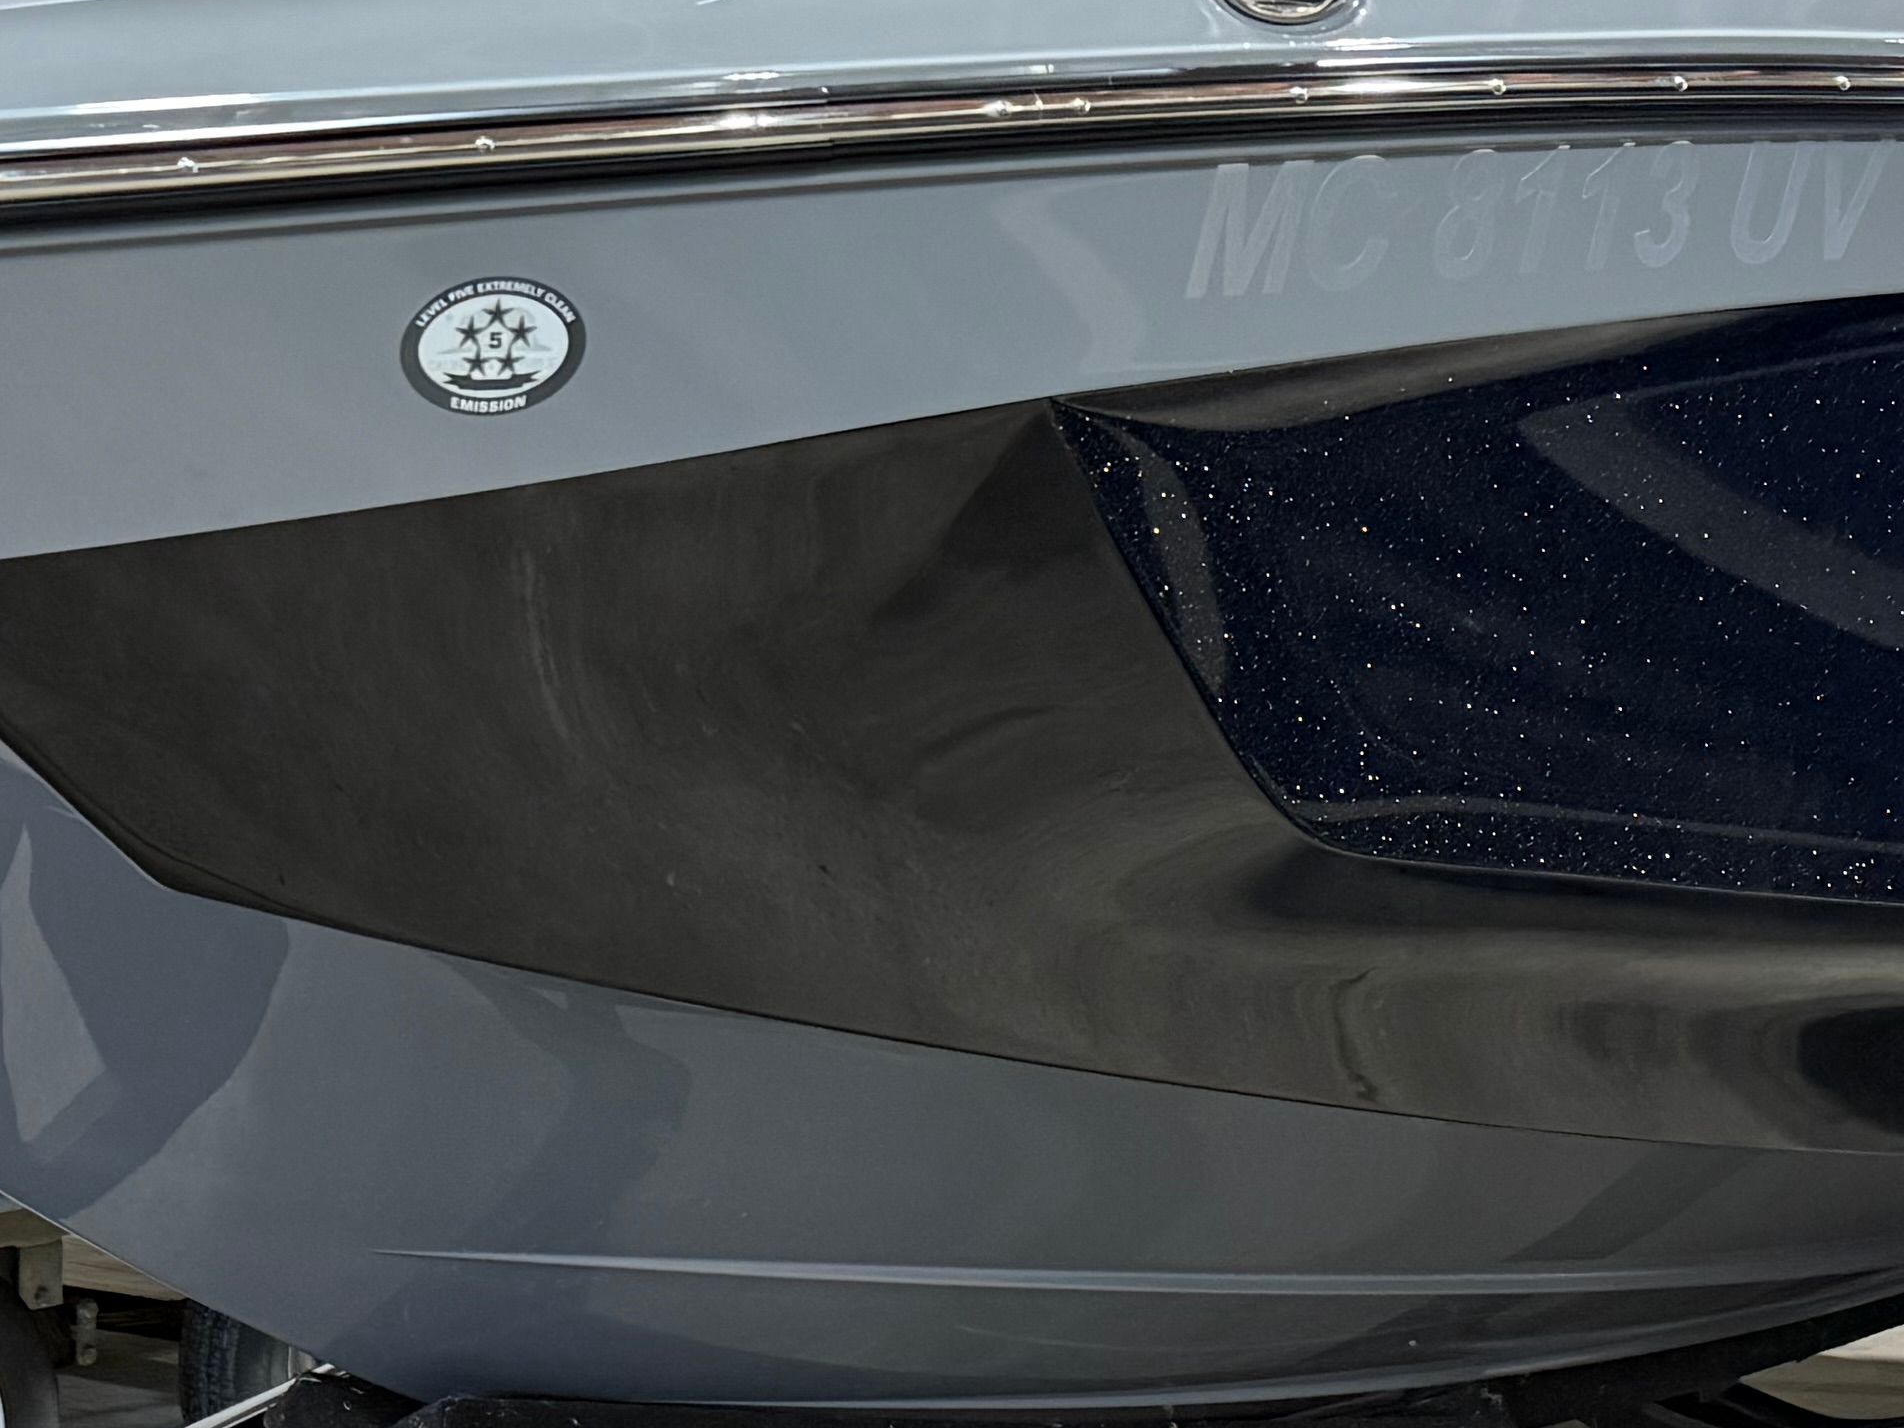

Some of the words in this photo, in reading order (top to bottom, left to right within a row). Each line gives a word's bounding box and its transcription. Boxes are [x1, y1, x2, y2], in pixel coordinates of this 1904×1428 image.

[1729, 139, 1898, 266] UV
[477, 280, 546, 298] EXTREMELY
[544, 291, 578, 324] CLEAN
[488, 331, 503, 349] 5
[449, 394, 528, 414] EMISSION
